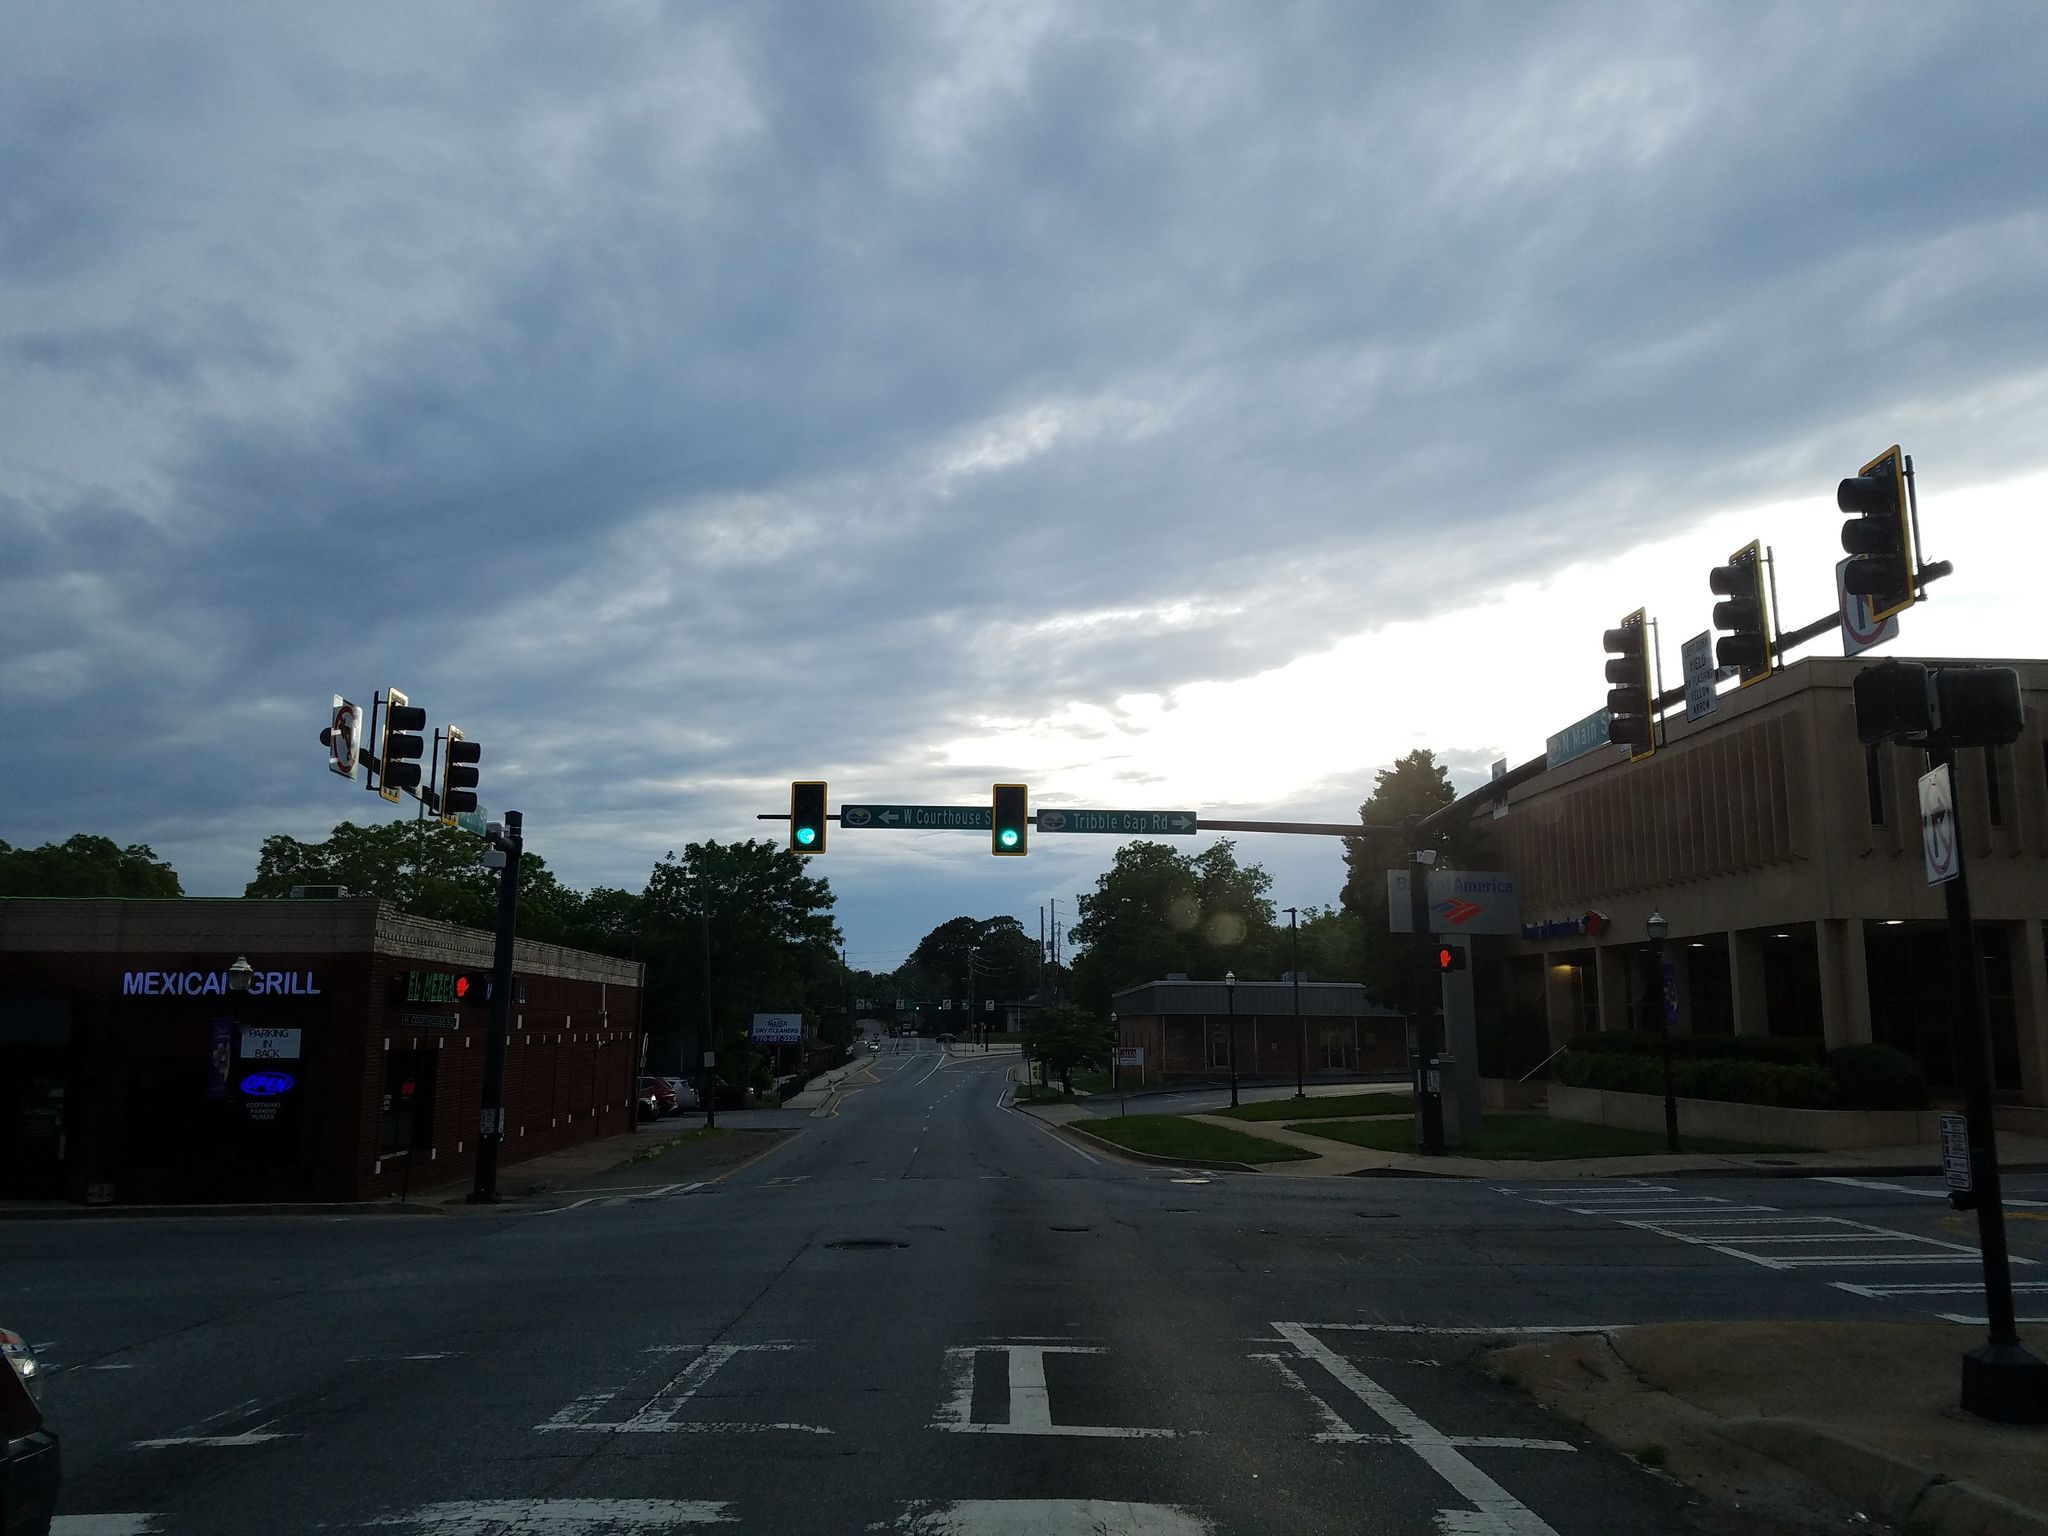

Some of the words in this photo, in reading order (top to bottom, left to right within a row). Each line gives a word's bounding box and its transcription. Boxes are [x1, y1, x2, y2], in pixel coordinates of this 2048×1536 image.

[1689, 654, 1706, 672] YIELD
[1691, 686, 1710, 701] YELLOW
[1562, 734, 1569, 754] N
[1572, 721, 1598, 749] Main
[904, 808, 912, 824] W
[916, 808, 981, 825] Courthouse
[1073, 813, 1118, 830] Tribble
[1123, 813, 1147, 832] Gap
[1152, 813, 1168, 830] Rd
[1454, 878, 1513, 893] America
[247, 970, 321, 996] GRILL
[249, 1029, 289, 1038] PARKING
[263, 1040, 273, 1048] IN
[245, 1075, 289, 1093] OPEN
